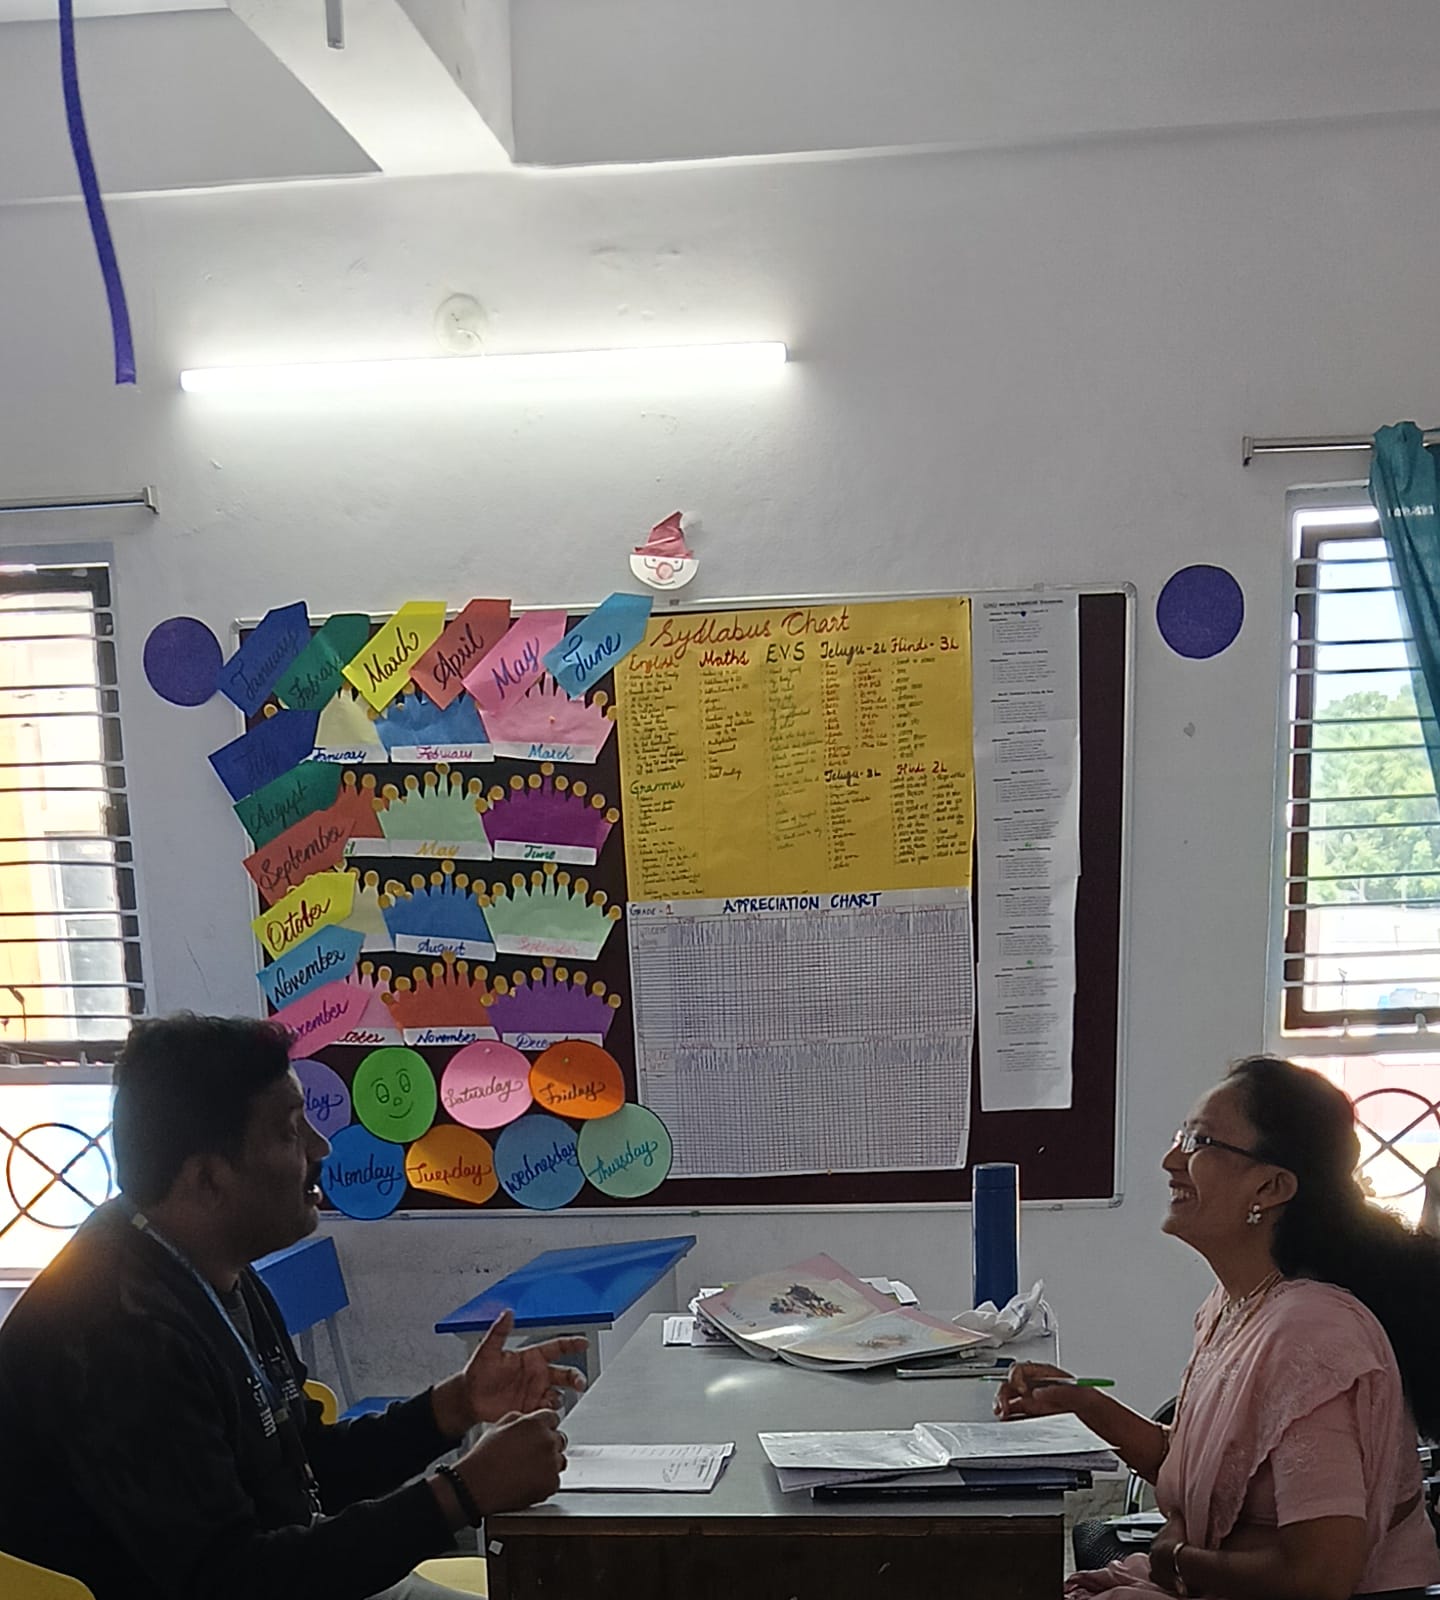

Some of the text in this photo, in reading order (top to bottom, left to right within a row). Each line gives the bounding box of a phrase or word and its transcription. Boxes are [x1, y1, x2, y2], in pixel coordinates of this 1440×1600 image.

[781, 605, 849, 636] Chart
[363, 627, 419, 693] March
[433, 623, 484, 690] April
[491, 637, 541, 699] May
[562, 632, 621, 683] June
[629, 654, 679, 674] English
[699, 649, 749, 668] Maths
[313, 747, 367, 764] January
[528, 744, 575, 761] March
[260, 825, 345, 892] September
[416, 839, 459, 858] May
[524, 844, 556, 860] June
[722, 895, 820, 914] APPRECIATION
[830, 892, 882, 909] CHART
[266, 898, 331, 952] October
[273, 946, 346, 1004] November
[416, 1029, 478, 1044] November
[444, 1076, 523, 1108] Saturday
[539, 1081, 606, 1105] Friday
[327, 1153, 403, 1196] Monday
[407, 1155, 492, 1185] Tuesday
[505, 1141, 578, 1195] Wednesday
